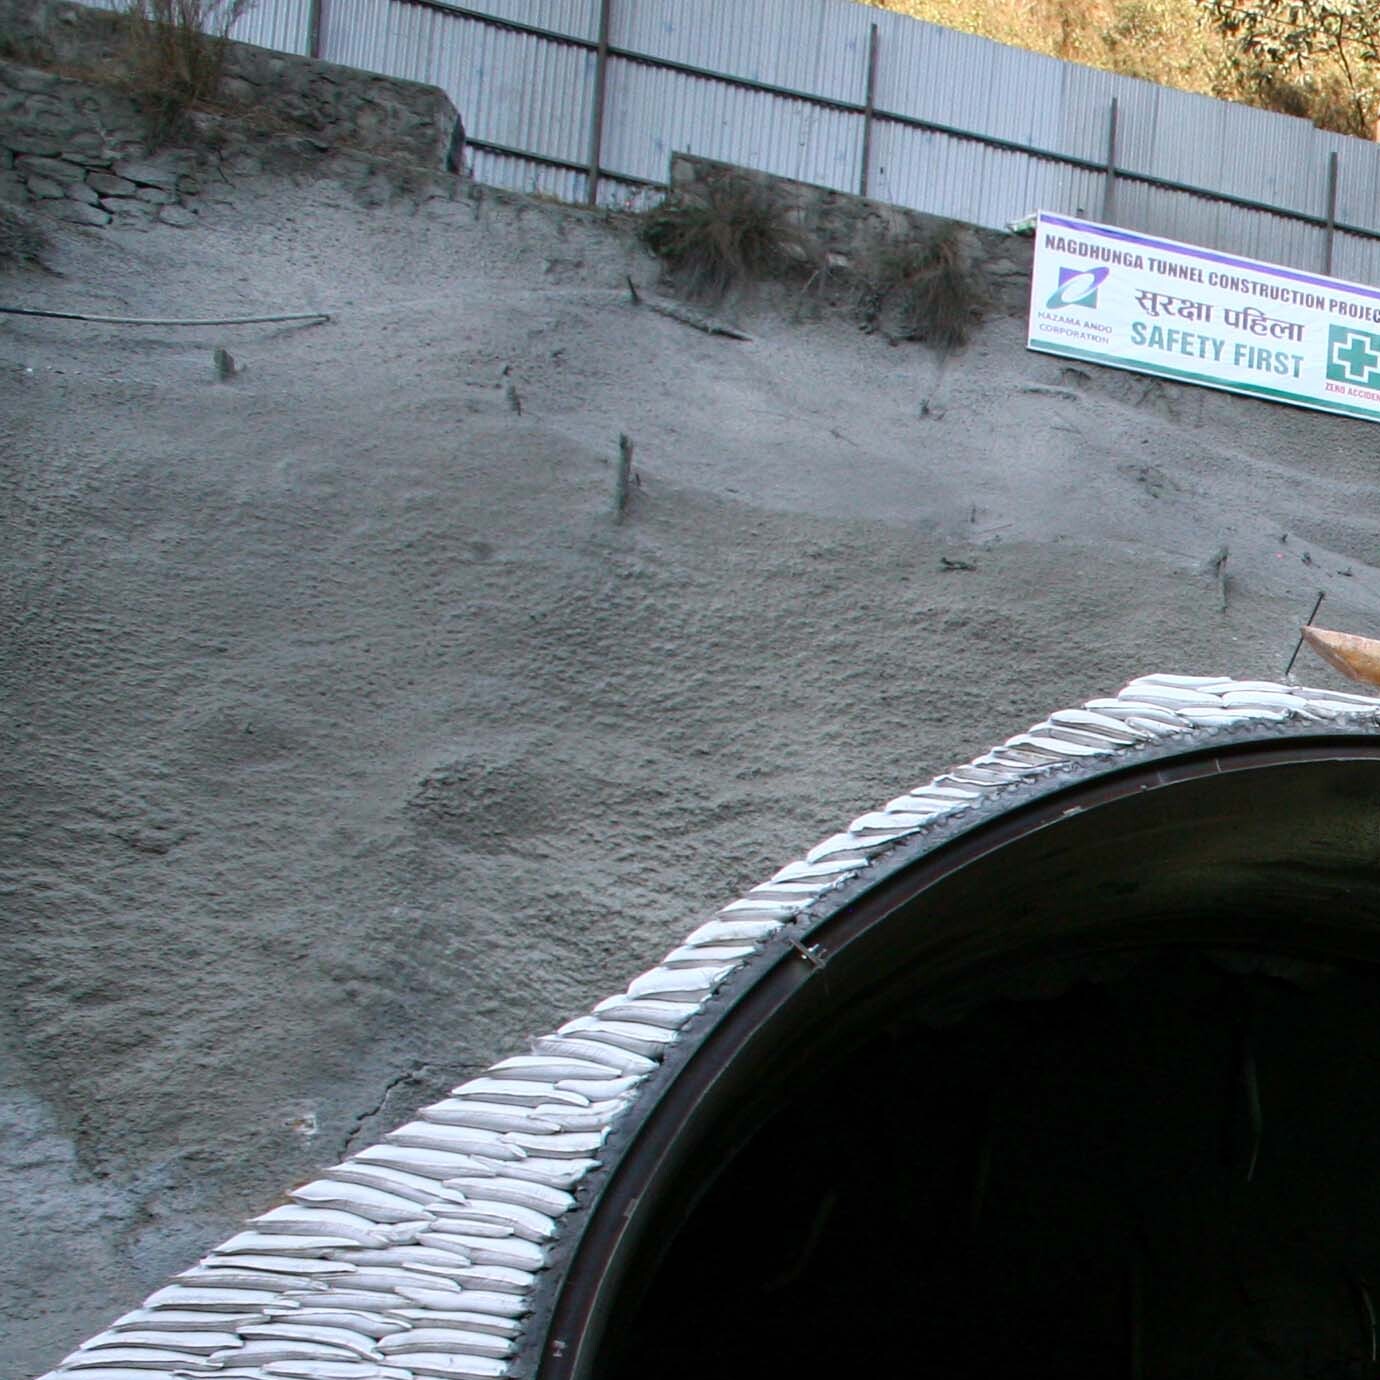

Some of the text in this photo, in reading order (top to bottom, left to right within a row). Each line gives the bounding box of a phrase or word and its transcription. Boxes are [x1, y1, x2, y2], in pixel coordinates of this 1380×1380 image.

[1045, 234, 1144, 270] NAGDHUNGA
[1148, 257, 1204, 284] TUNNEL
[1208, 272, 1325, 310] CONSTRUCTION
[1038, 311, 1113, 334] HAZAMA ANDO
[1039, 323, 1110, 345] CORPORATION
[1135, 288, 1305, 342] सुरक्षा पहिला
[1131, 321, 1304, 379] SAFETY FIRST
[1325, 383, 1346, 394] ZERO
